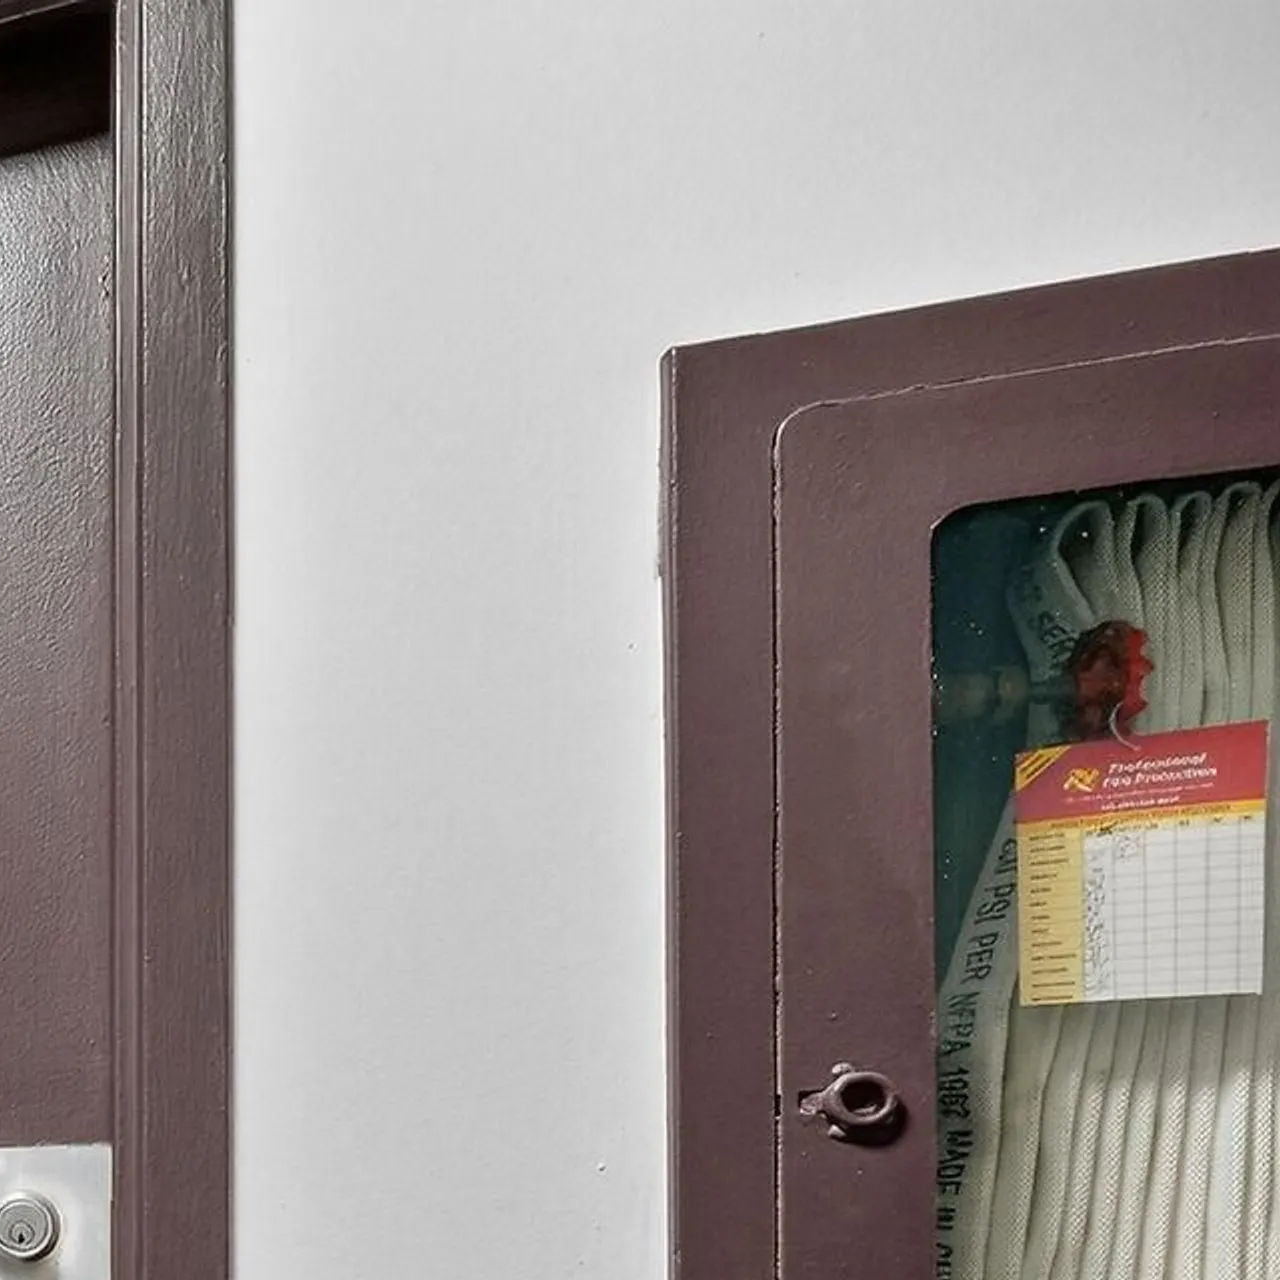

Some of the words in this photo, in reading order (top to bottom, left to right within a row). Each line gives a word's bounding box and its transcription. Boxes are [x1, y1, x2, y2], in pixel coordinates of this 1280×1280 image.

[973, 884, 1017, 926] PSI
[959, 931, 1000, 985] PER
[939, 990, 981, 1057] NFPA
